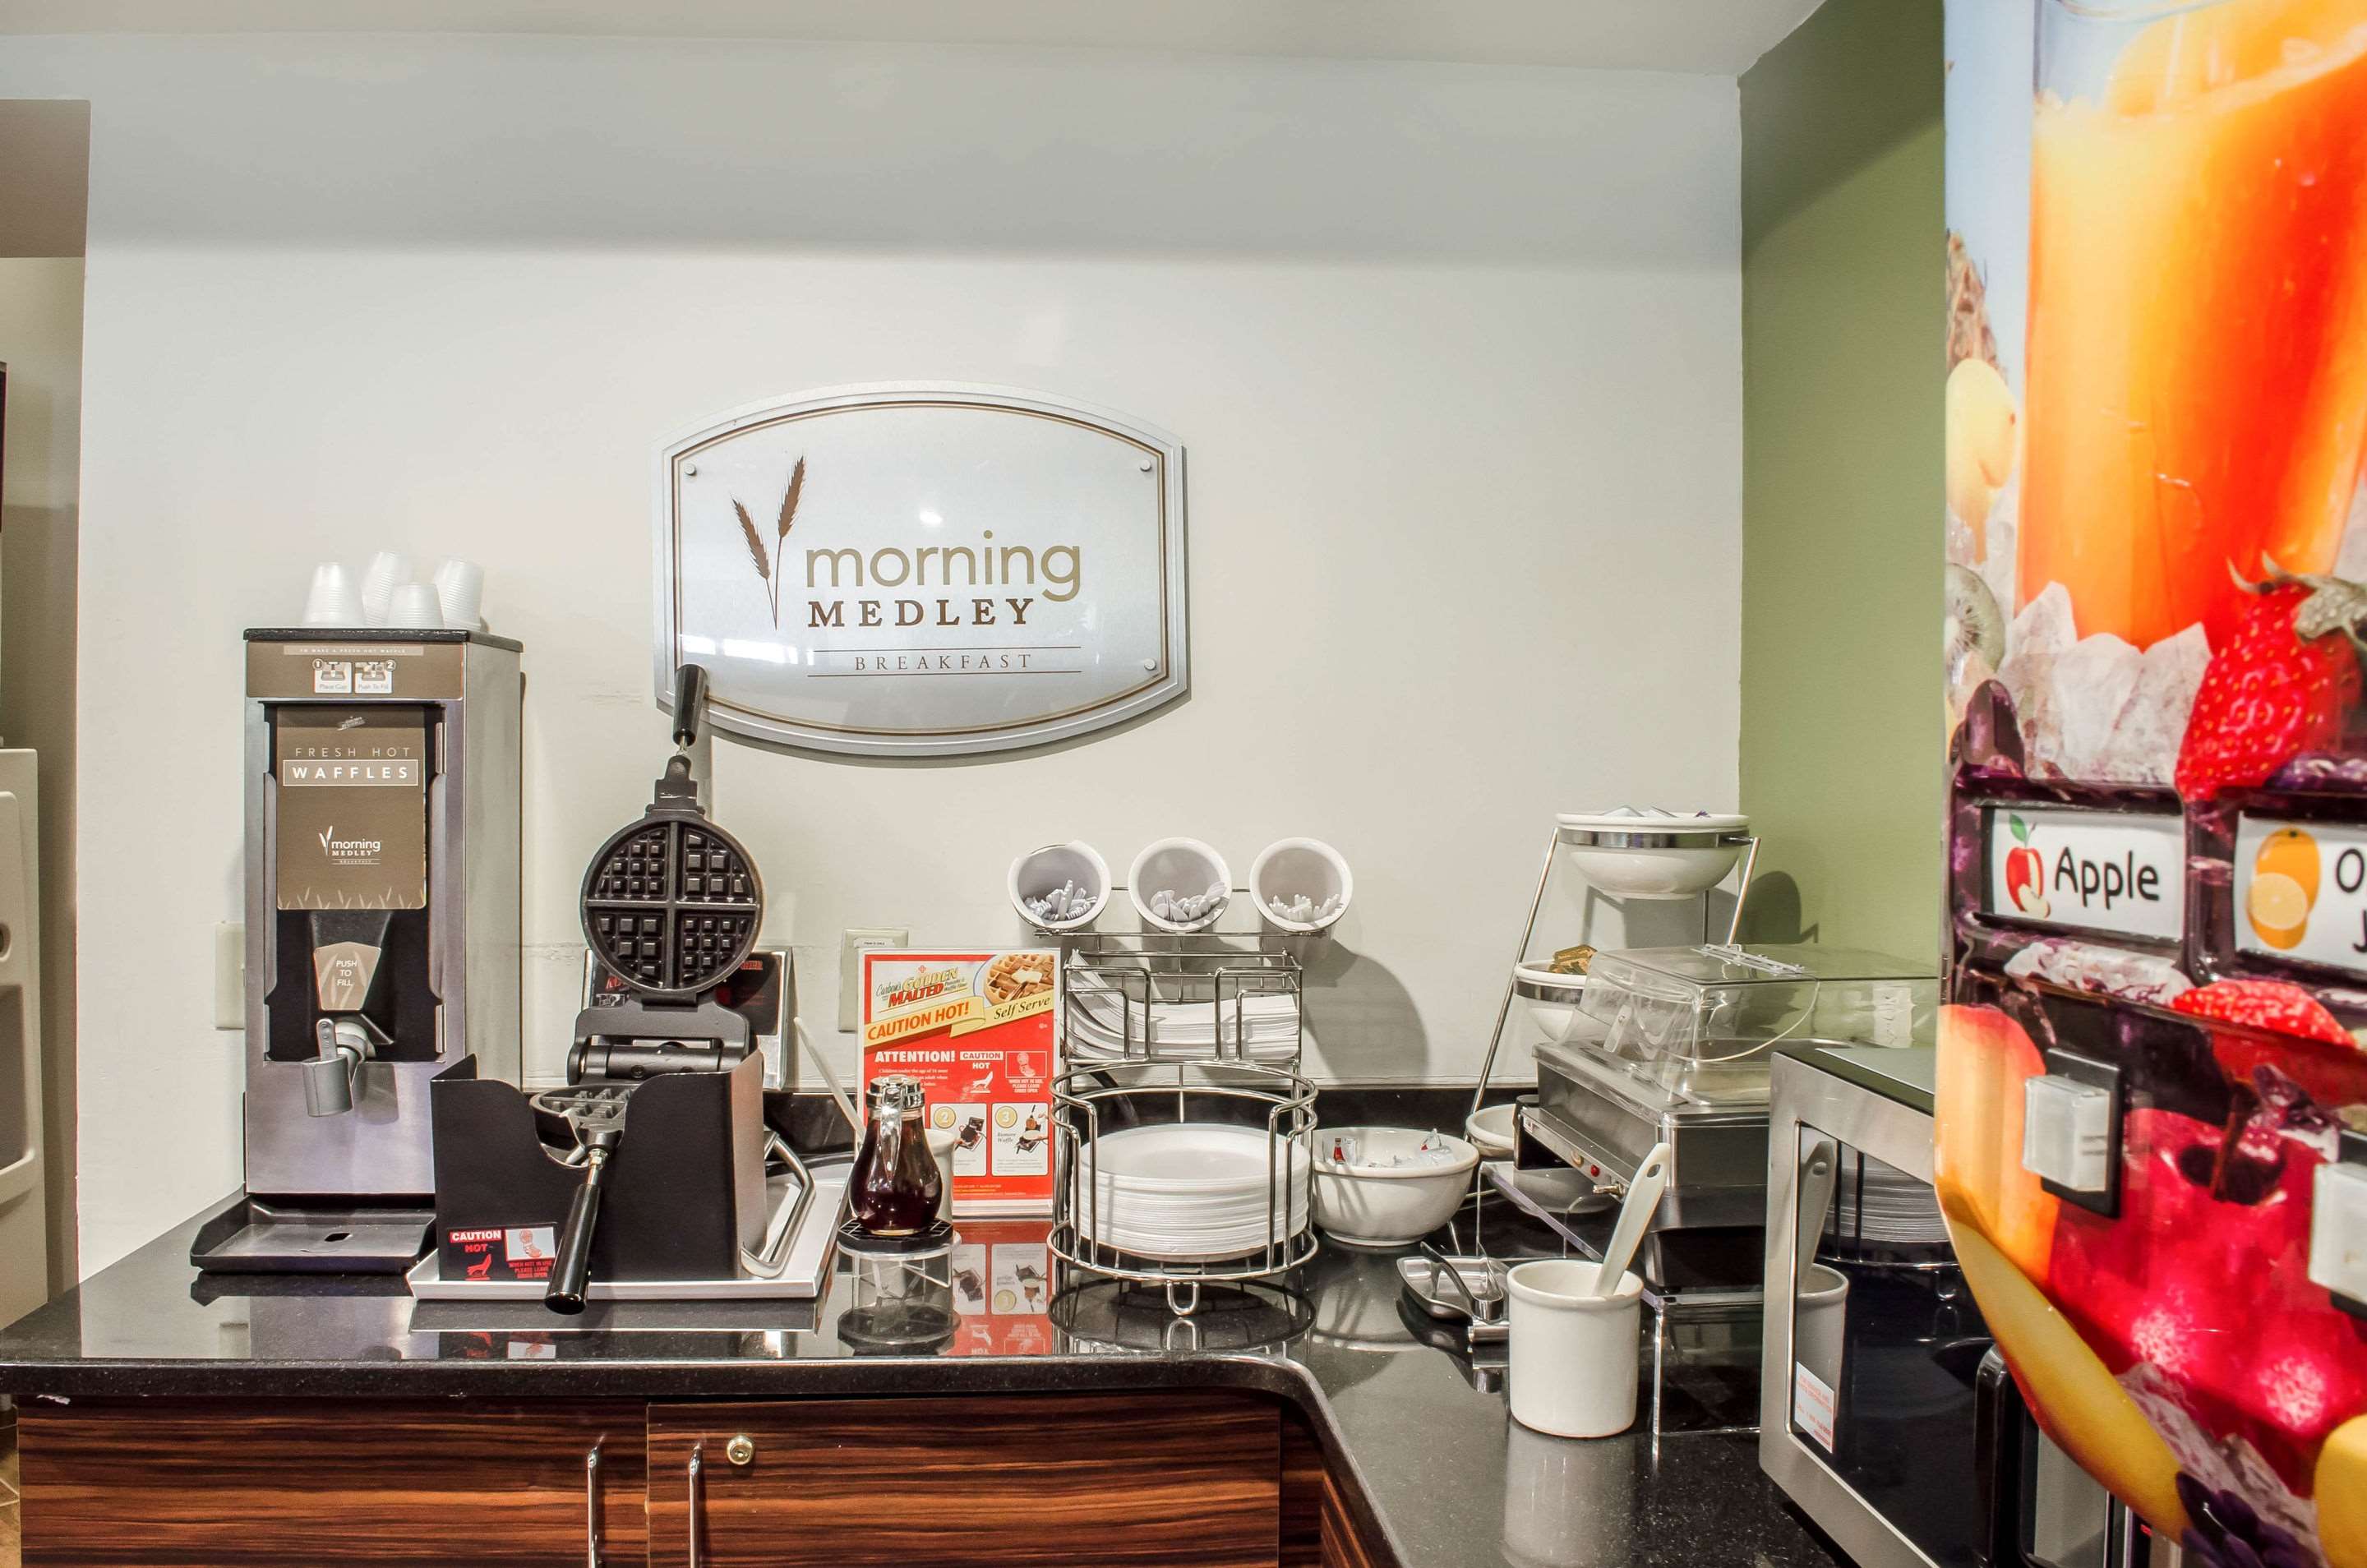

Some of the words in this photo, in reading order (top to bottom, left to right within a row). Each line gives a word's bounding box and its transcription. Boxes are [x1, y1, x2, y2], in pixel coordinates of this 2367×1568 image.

[806, 529, 1080, 602] morning
[808, 597, 1035, 628] MEDLEY
[854, 653, 1034, 671] BREAKFAST
[295, 747, 356, 757] FRESH
[372, 747, 411, 757] HOT
[293, 767, 408, 779] WAFFLES
[331, 838, 381, 851] morning
[2054, 846, 2161, 911] Apple
[339, 969, 352, 977] TO
[336, 979, 353, 987] FILL
[888, 983, 944, 1008] MALTED
[994, 1003, 1017, 1019] Self
[1017, 997, 1050, 1013] Serve
[868, 1011, 931, 1040] CAUTION
[934, 1001, 970, 1023] HOT!
[874, 1049, 955, 1063] ATTENTION!
[451, 1230, 501, 1242] CAUTION
[464, 1243, 488, 1252] HOT
